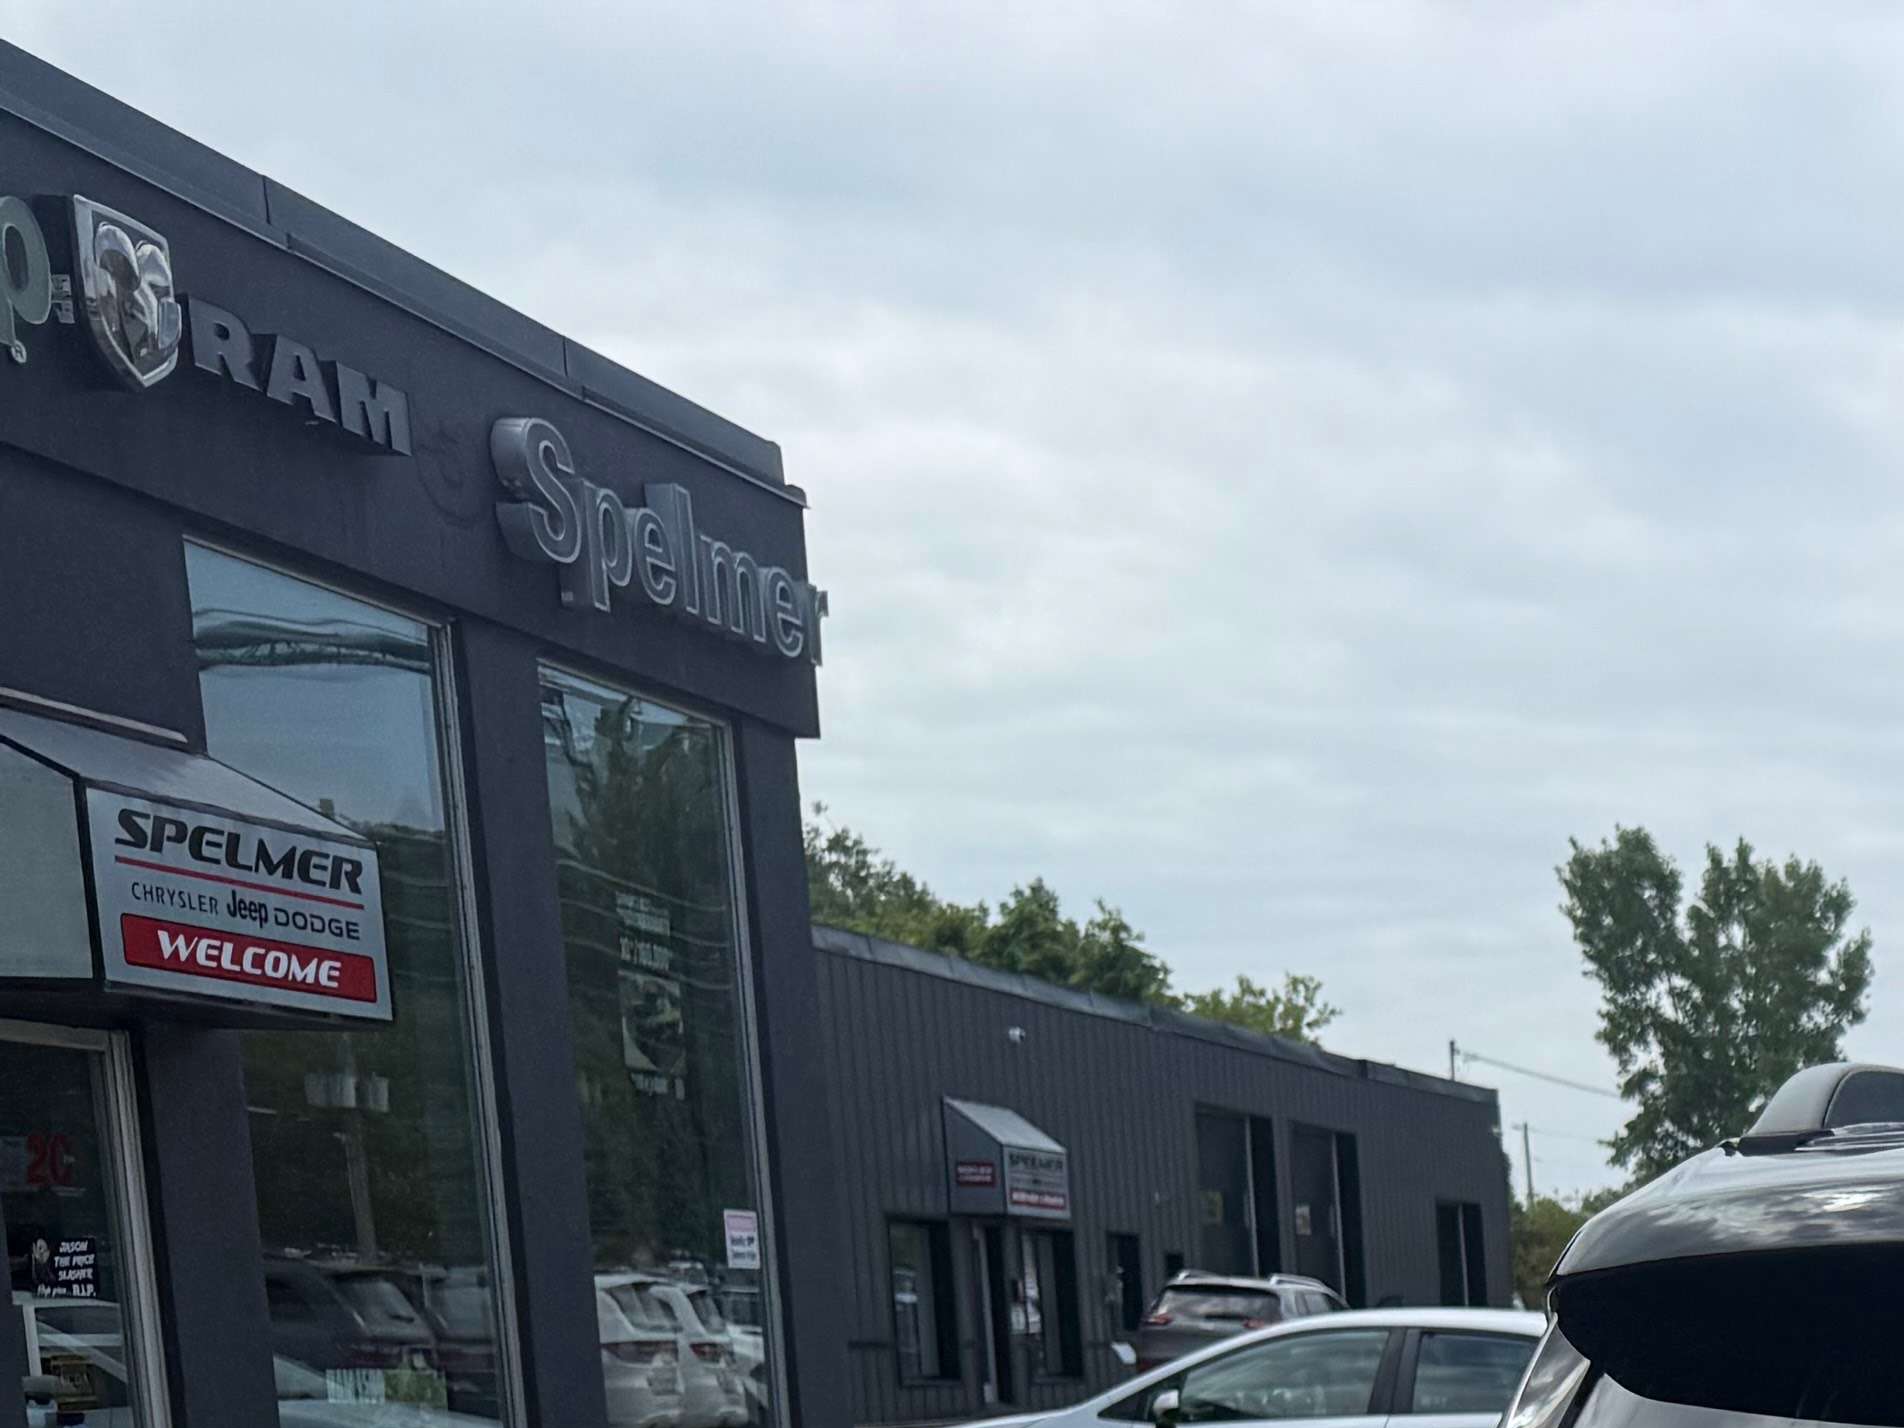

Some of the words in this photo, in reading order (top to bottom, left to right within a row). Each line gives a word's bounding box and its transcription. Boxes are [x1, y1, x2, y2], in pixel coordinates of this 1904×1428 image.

[188, 296, 411, 457] RAM
[490, 417, 828, 667] Spelmer
[114, 807, 363, 895] SPELMER
[131, 882, 219, 916] CHRYSLER
[226, 889, 269, 929] Jeep
[273, 907, 361, 941] DODGE
[157, 929, 342, 988] WELCOME
